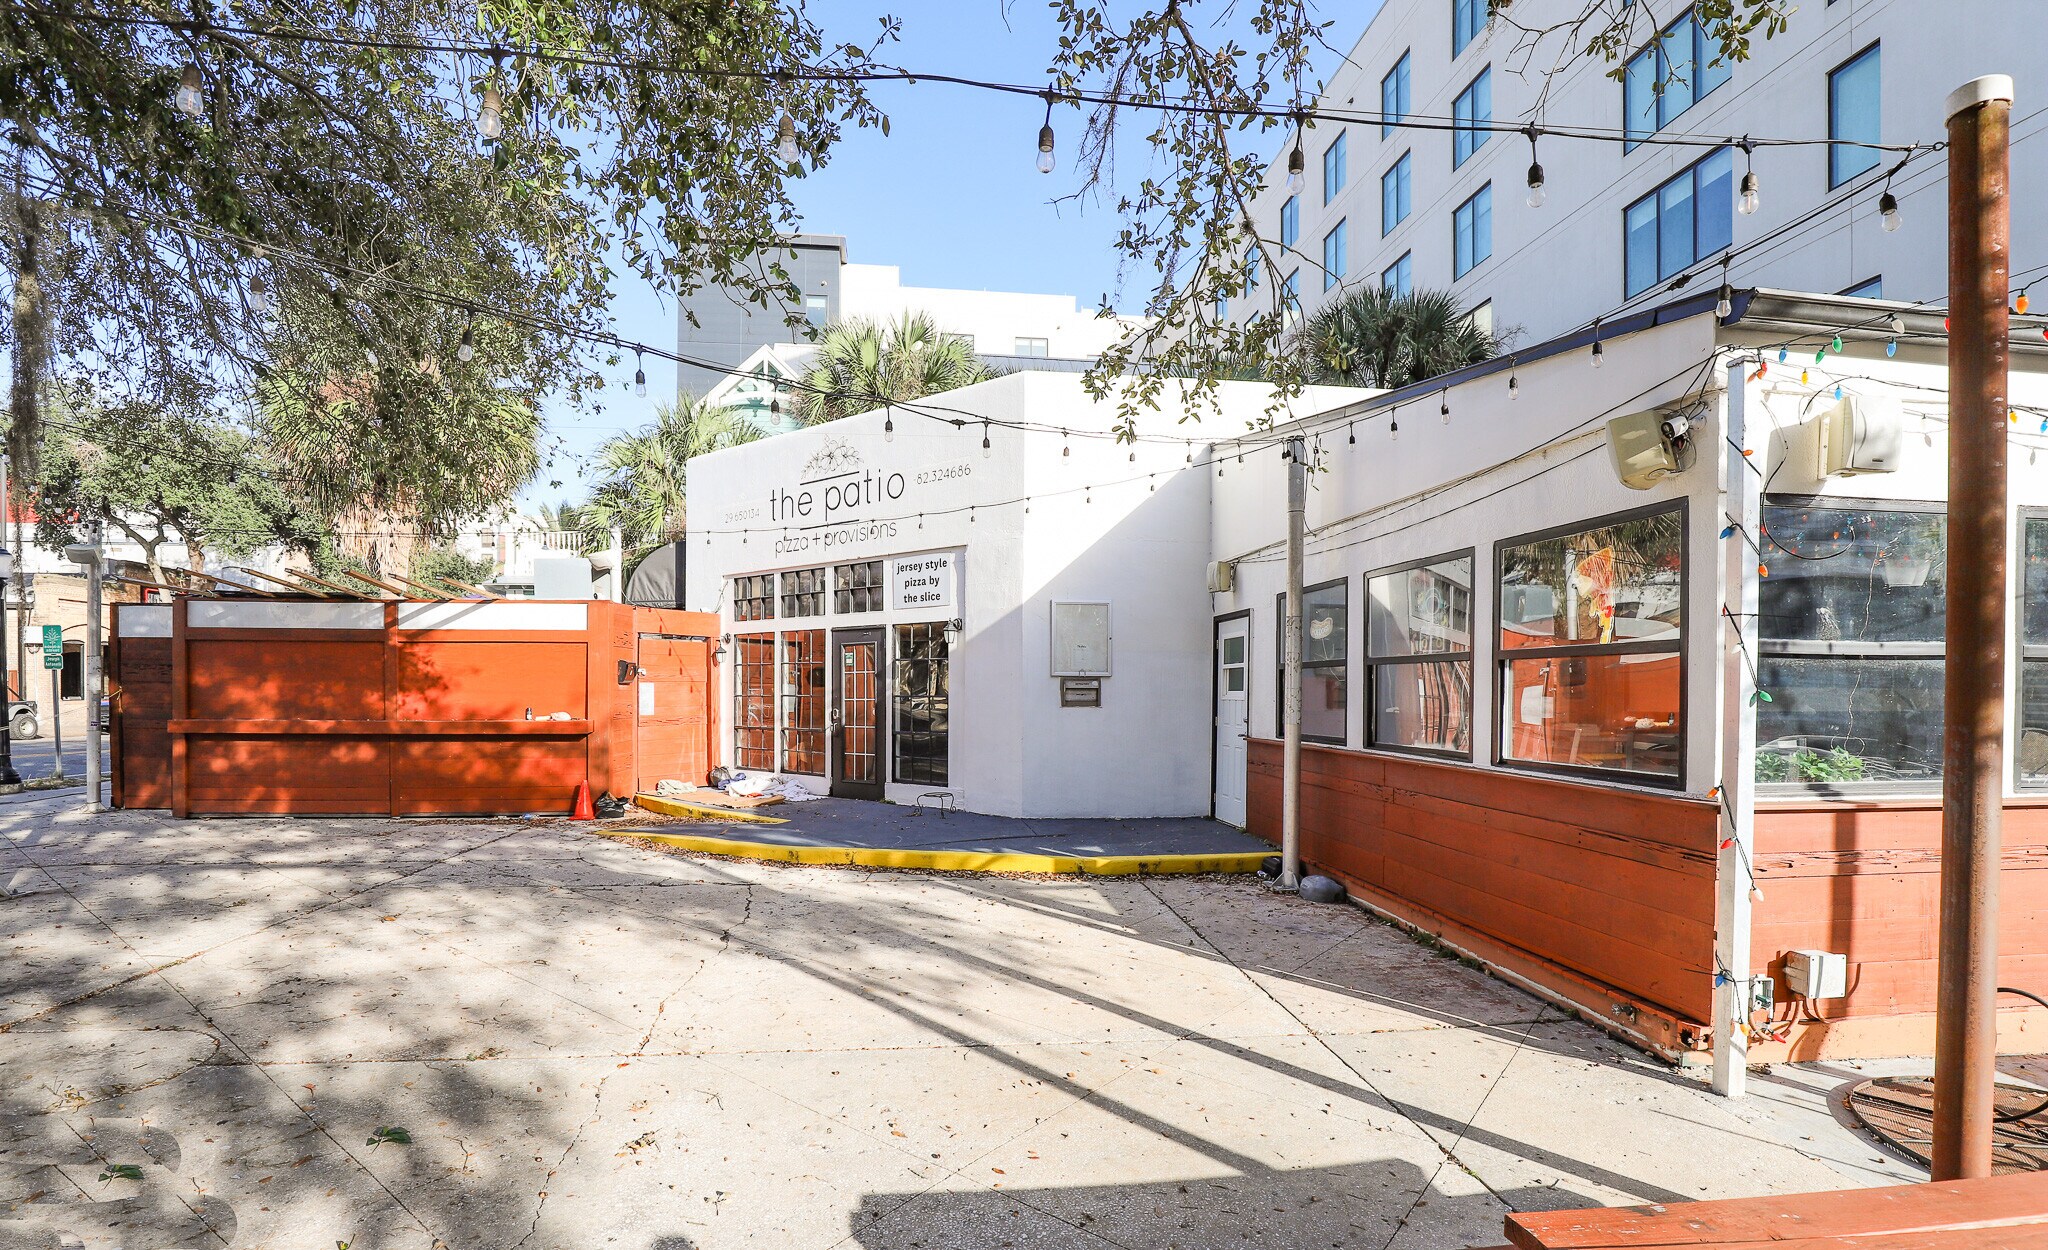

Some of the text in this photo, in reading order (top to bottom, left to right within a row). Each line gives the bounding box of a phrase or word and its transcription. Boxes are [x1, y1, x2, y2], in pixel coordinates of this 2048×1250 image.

[770, 469, 905, 521] the patio
[724, 508, 760, 524] 29650134
[775, 536, 809, 558] pizza
[824, 522, 897, 551] provisions
[896, 558, 948, 575] jersey style
[904, 575, 940, 590] pizza by
[903, 591, 941, 603] the slice
